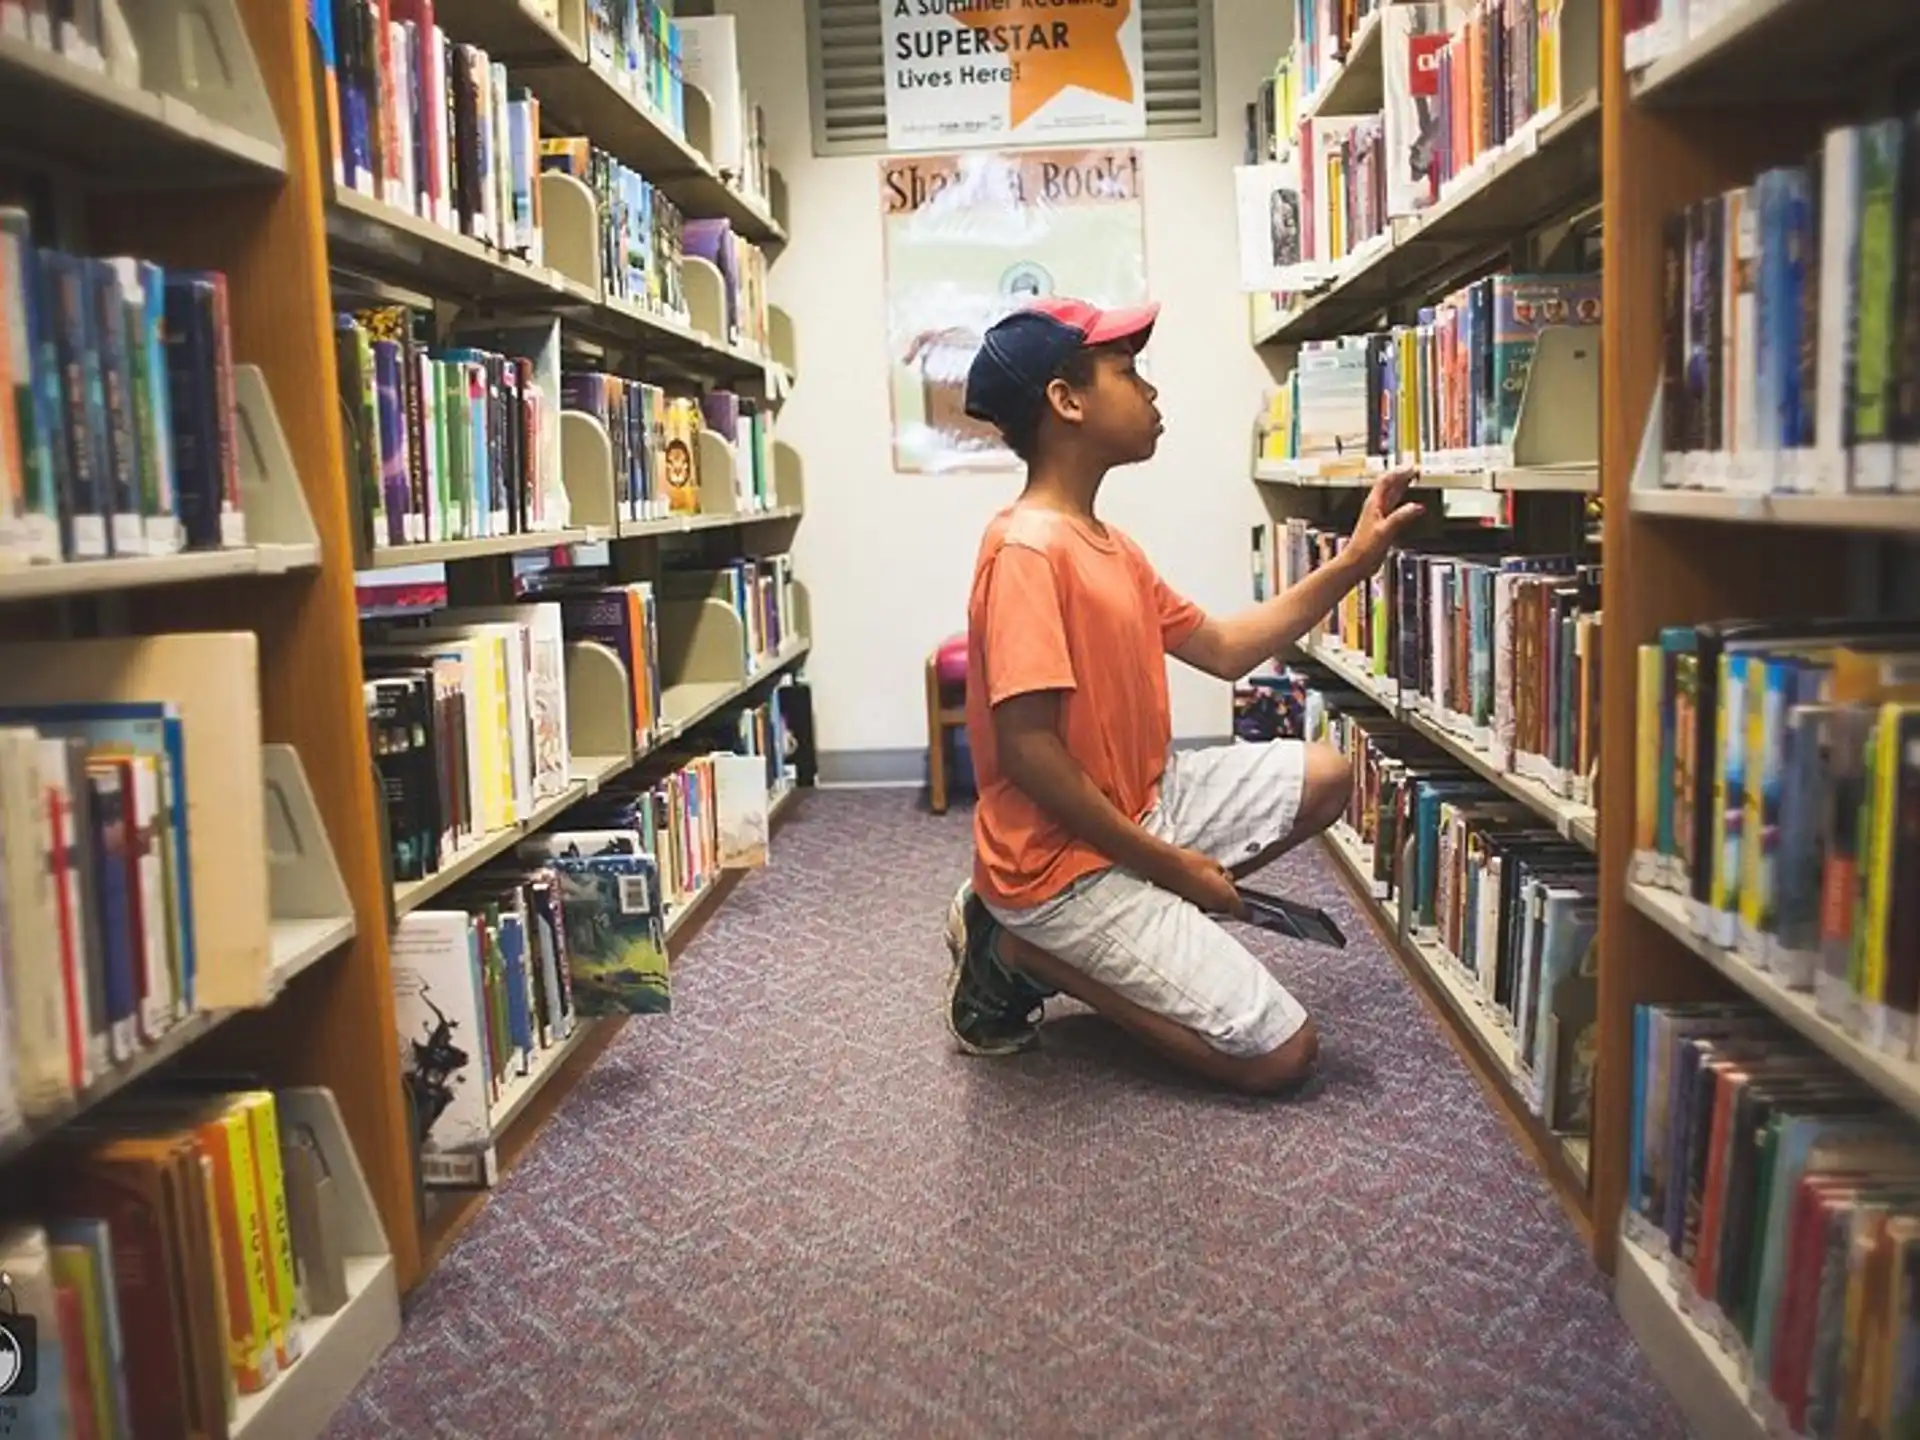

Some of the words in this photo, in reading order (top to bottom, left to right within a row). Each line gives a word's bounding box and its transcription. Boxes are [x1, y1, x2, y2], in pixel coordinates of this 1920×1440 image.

[894, 0, 911, 18] A
[896, 21, 1070, 60] SUPERSTAR
[897, 67, 953, 89] Lives
[959, 61, 1021, 85] Here!
